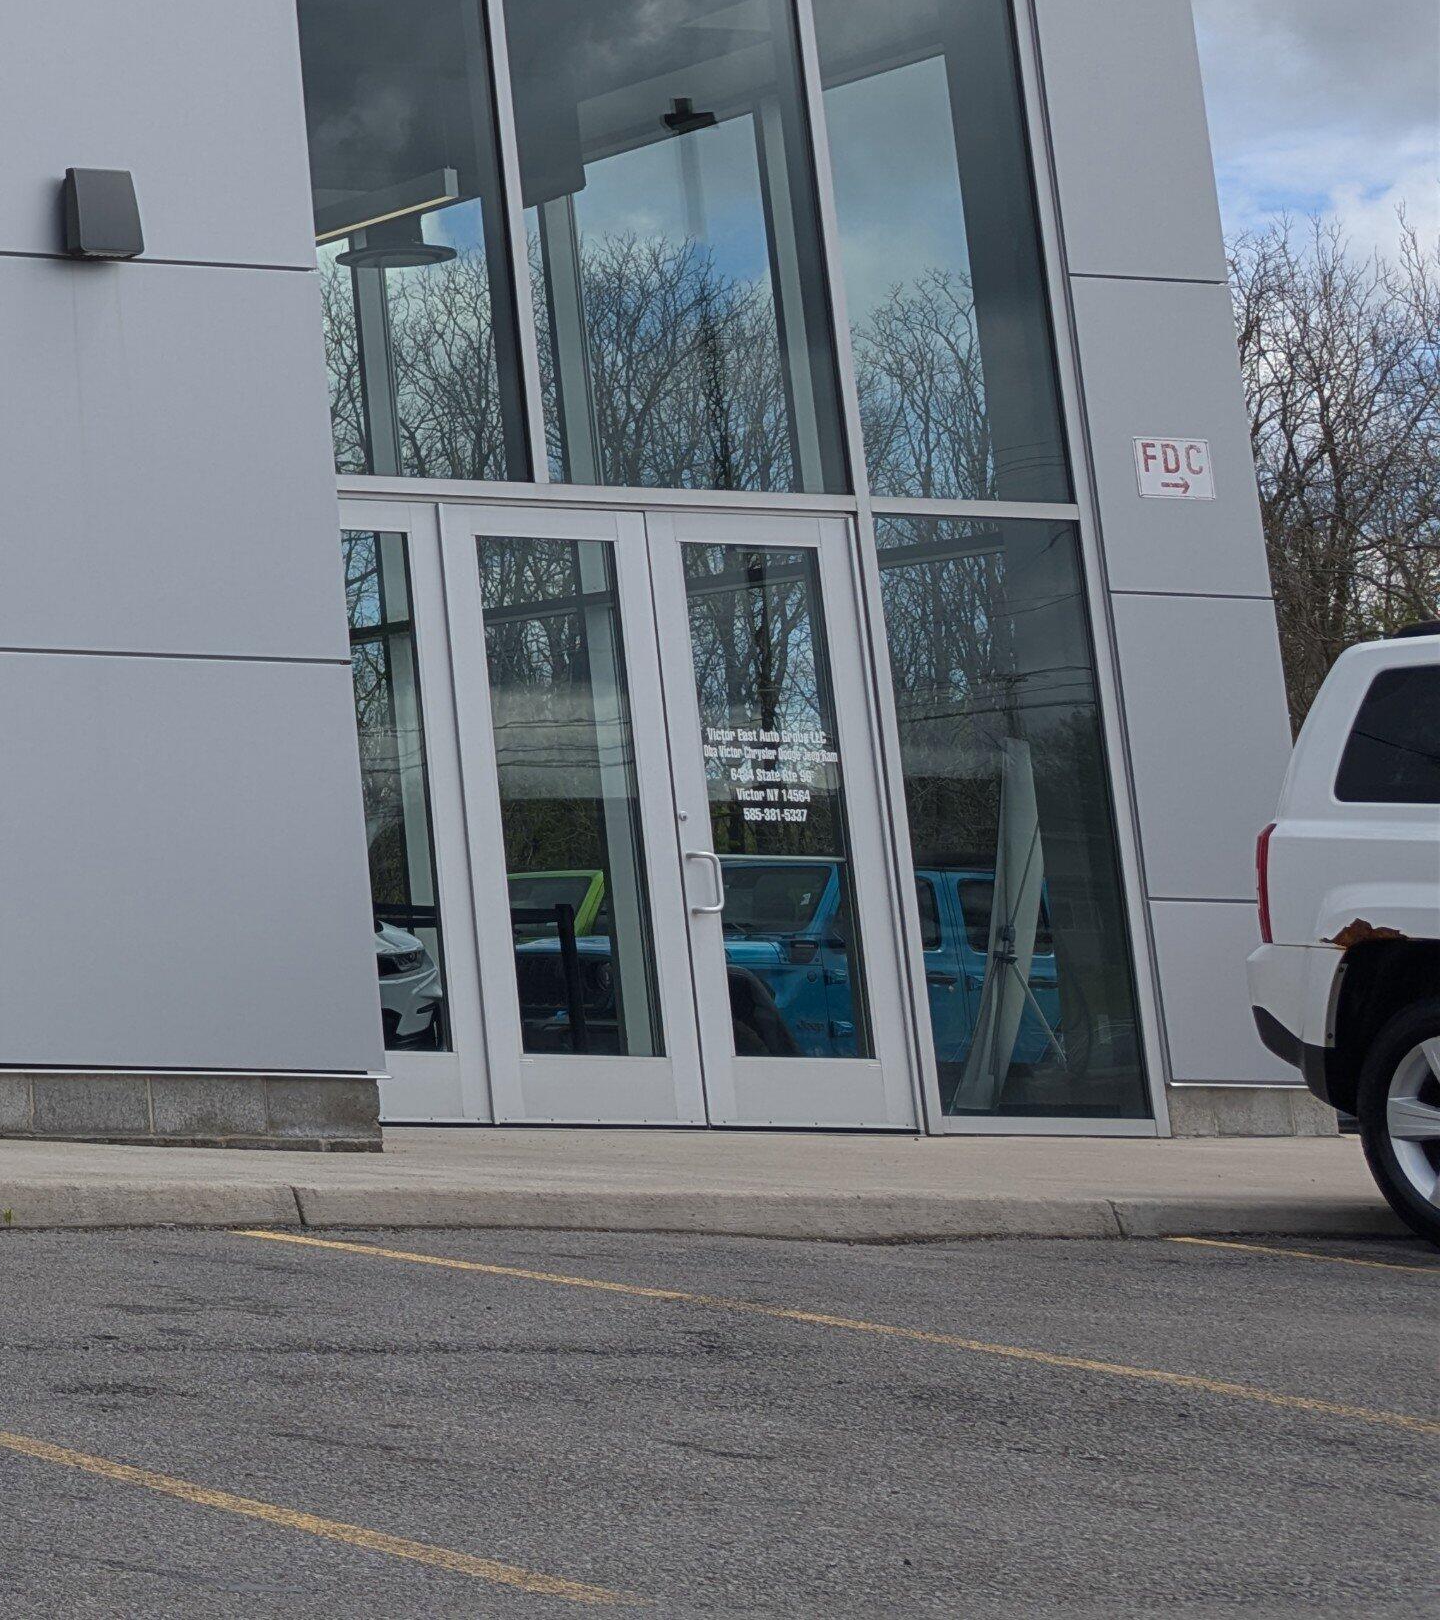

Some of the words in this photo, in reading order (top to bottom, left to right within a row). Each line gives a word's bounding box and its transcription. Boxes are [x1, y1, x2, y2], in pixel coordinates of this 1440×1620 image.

[1141, 442, 1204, 475] FDC
[707, 727, 735, 740] Victor
[738, 728, 758, 741] East
[760, 728, 780, 742] Auto
[719, 745, 742, 758] Victor
[744, 746, 777, 760] Chrysler
[757, 768, 780, 781] State
[737, 787, 764, 801] Victor
[767, 788, 779, 801] NY
[782, 789, 811, 802] 14564
